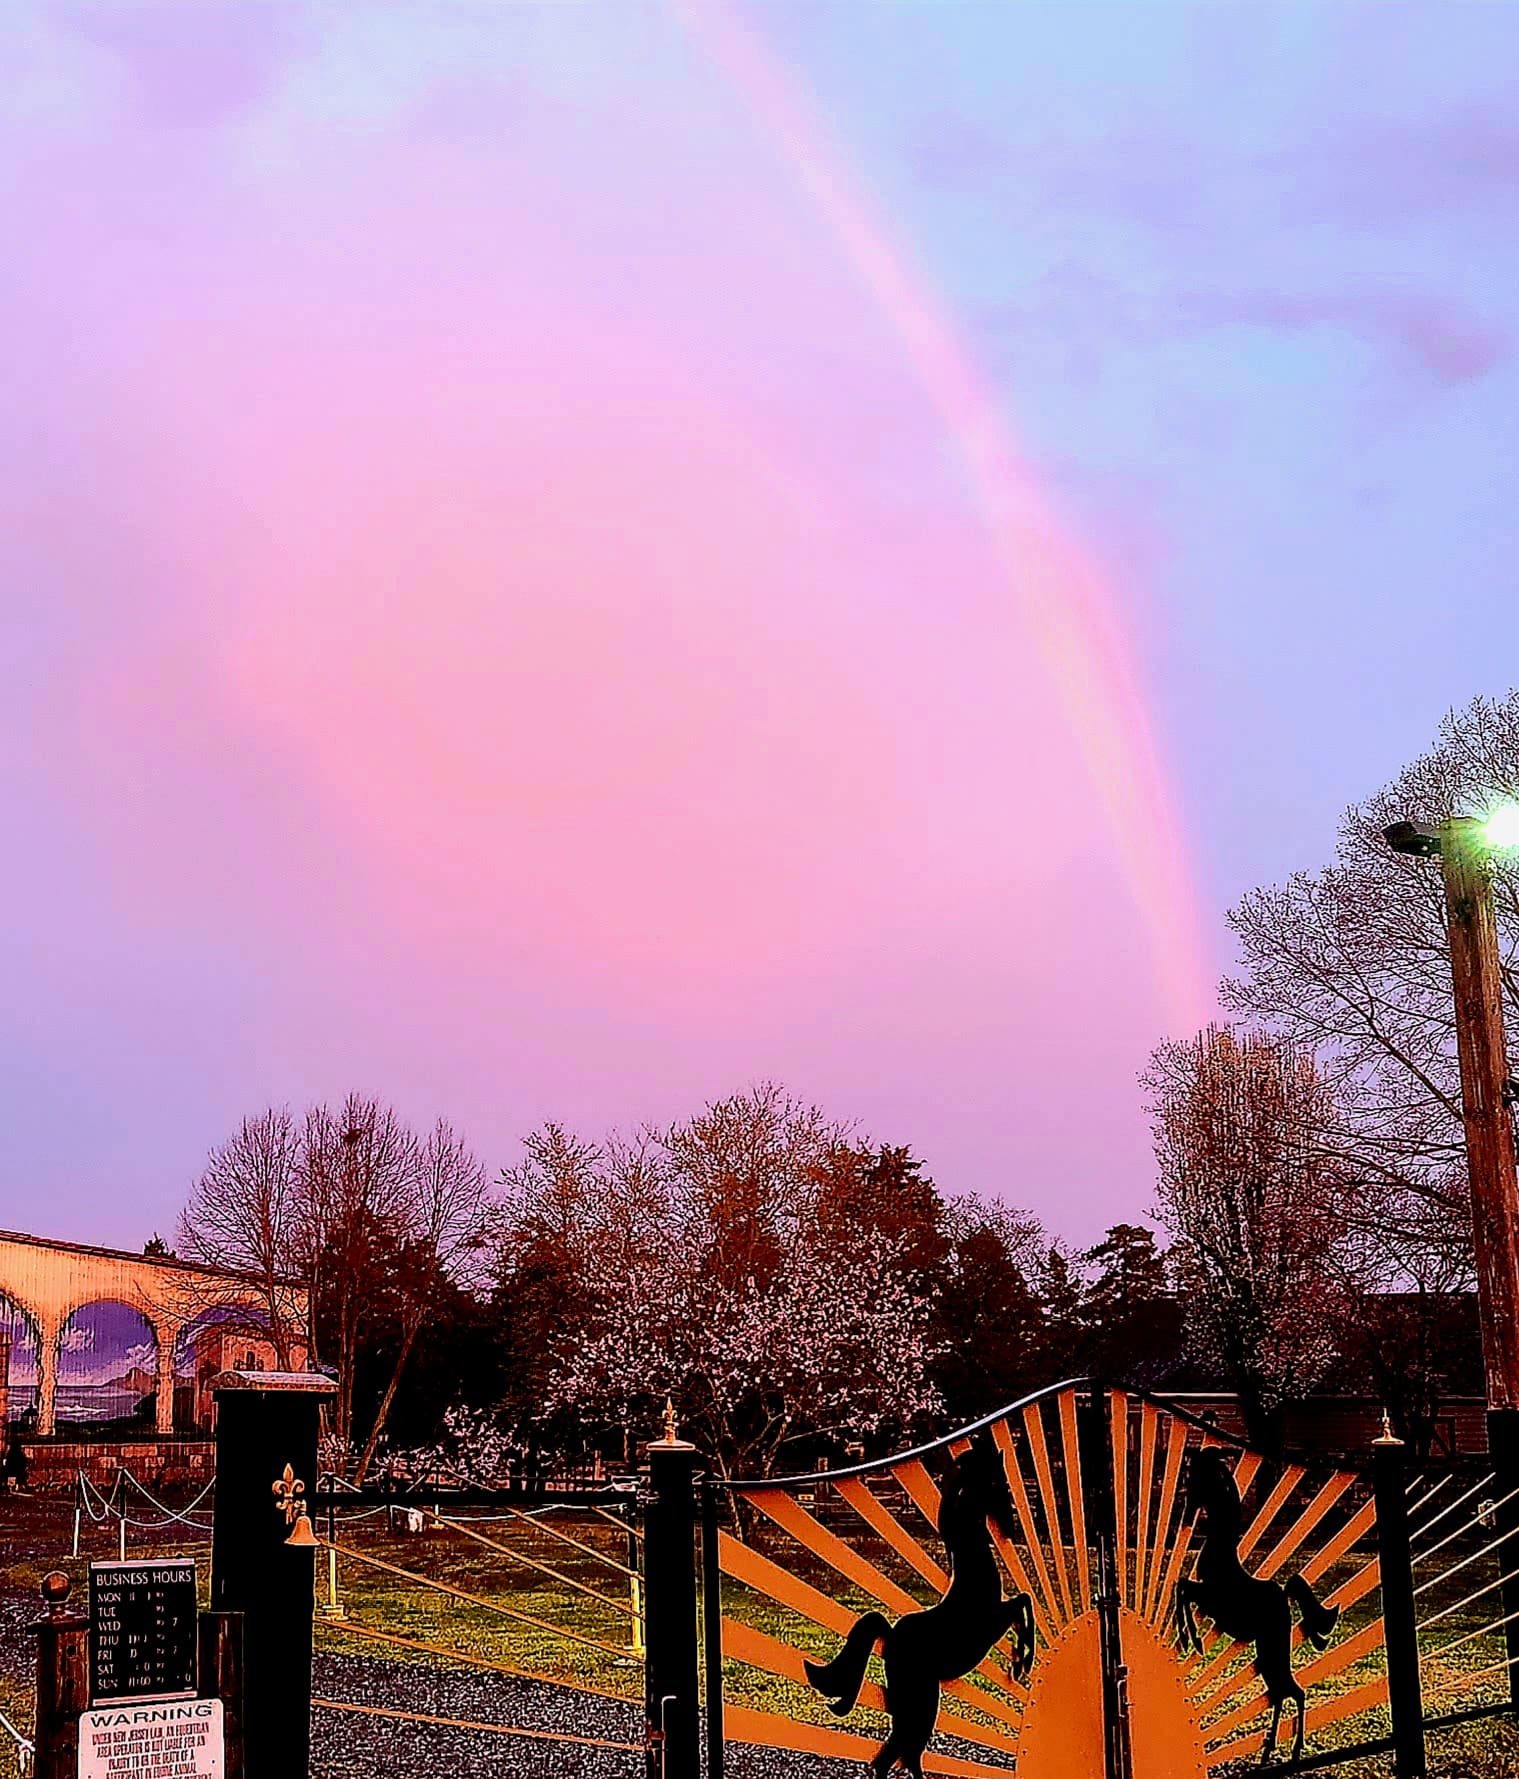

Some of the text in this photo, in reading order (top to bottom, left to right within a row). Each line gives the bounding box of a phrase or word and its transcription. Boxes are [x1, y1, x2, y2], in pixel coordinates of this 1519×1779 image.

[96, 1569, 192, 1587] BUSINESS HOURS
[97, 1592, 121, 1603] MON
[97, 1606, 116, 1617] TUE
[98, 1620, 121, 1631] WED
[99, 1635, 119, 1646] THU
[97, 1649, 112, 1660] FRI
[97, 1663, 114, 1676] SAT
[90, 1704, 212, 1728] WARNING
